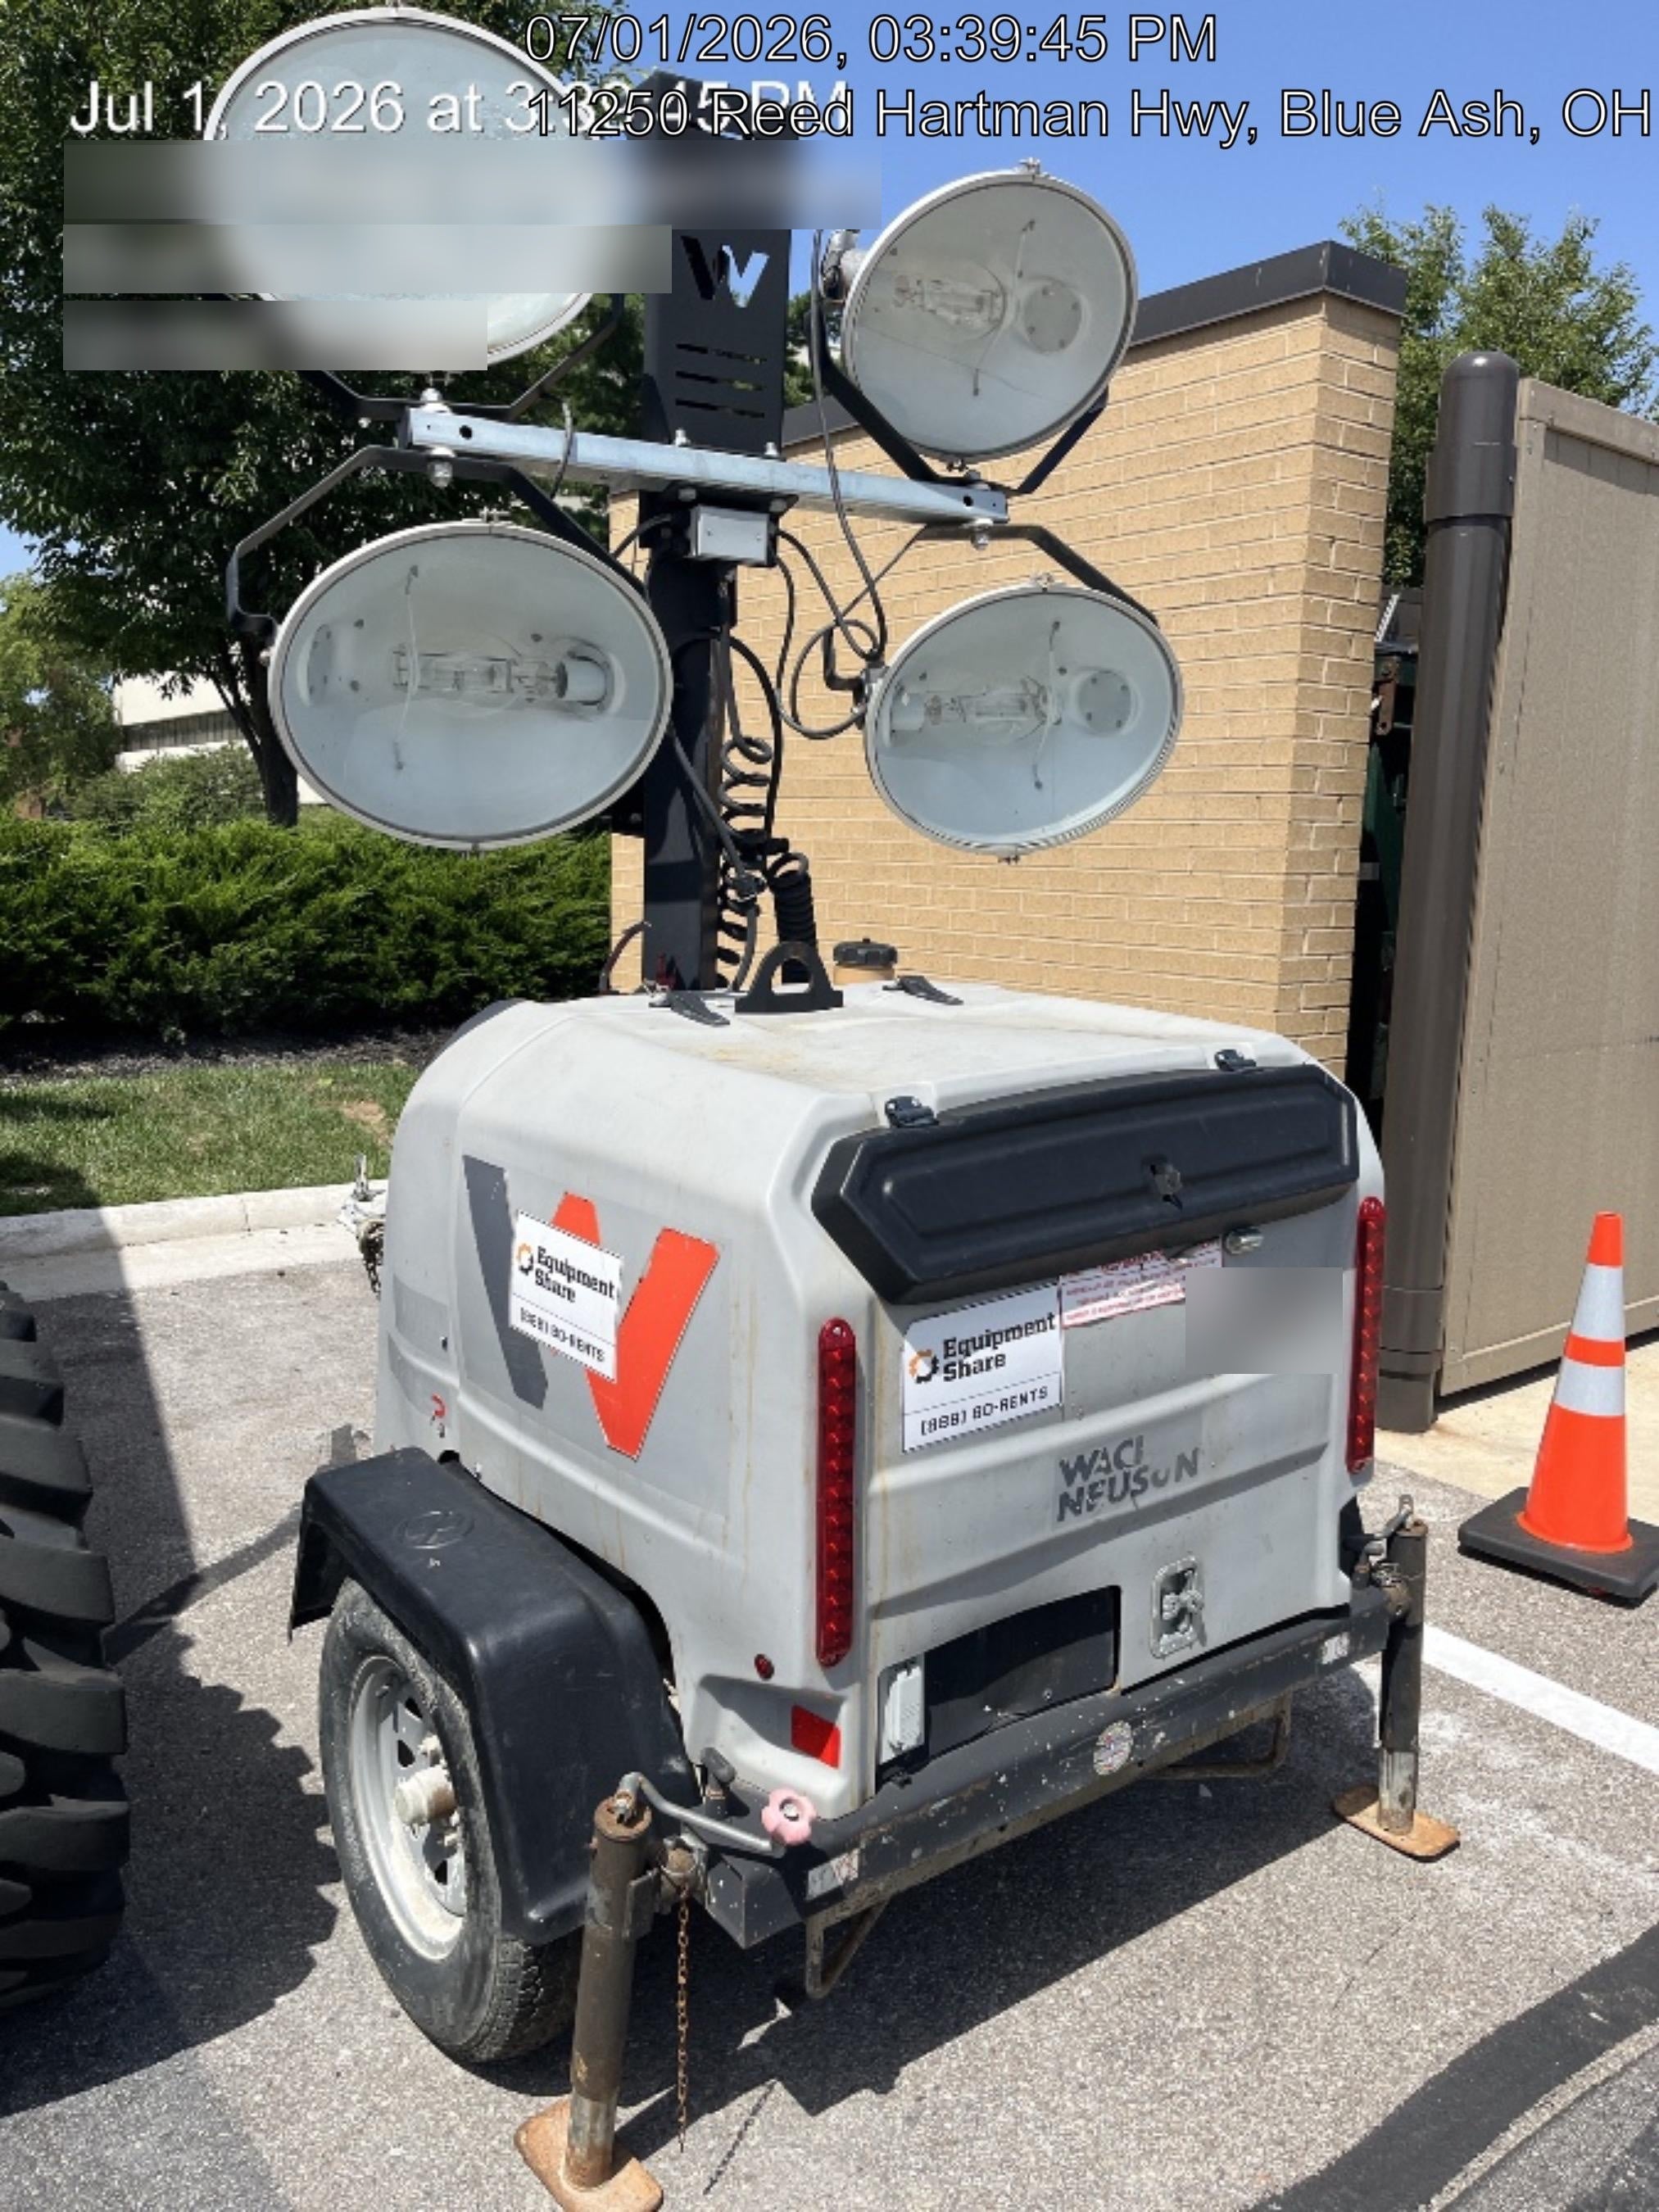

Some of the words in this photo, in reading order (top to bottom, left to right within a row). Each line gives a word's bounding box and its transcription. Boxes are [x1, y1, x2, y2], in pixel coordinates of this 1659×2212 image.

[535, 1267, 576, 1303] Share
[537, 1245, 615, 1300] Equipment
[943, 1312, 1055, 1360] Equipment
[943, 1353, 1006, 1382] Share
